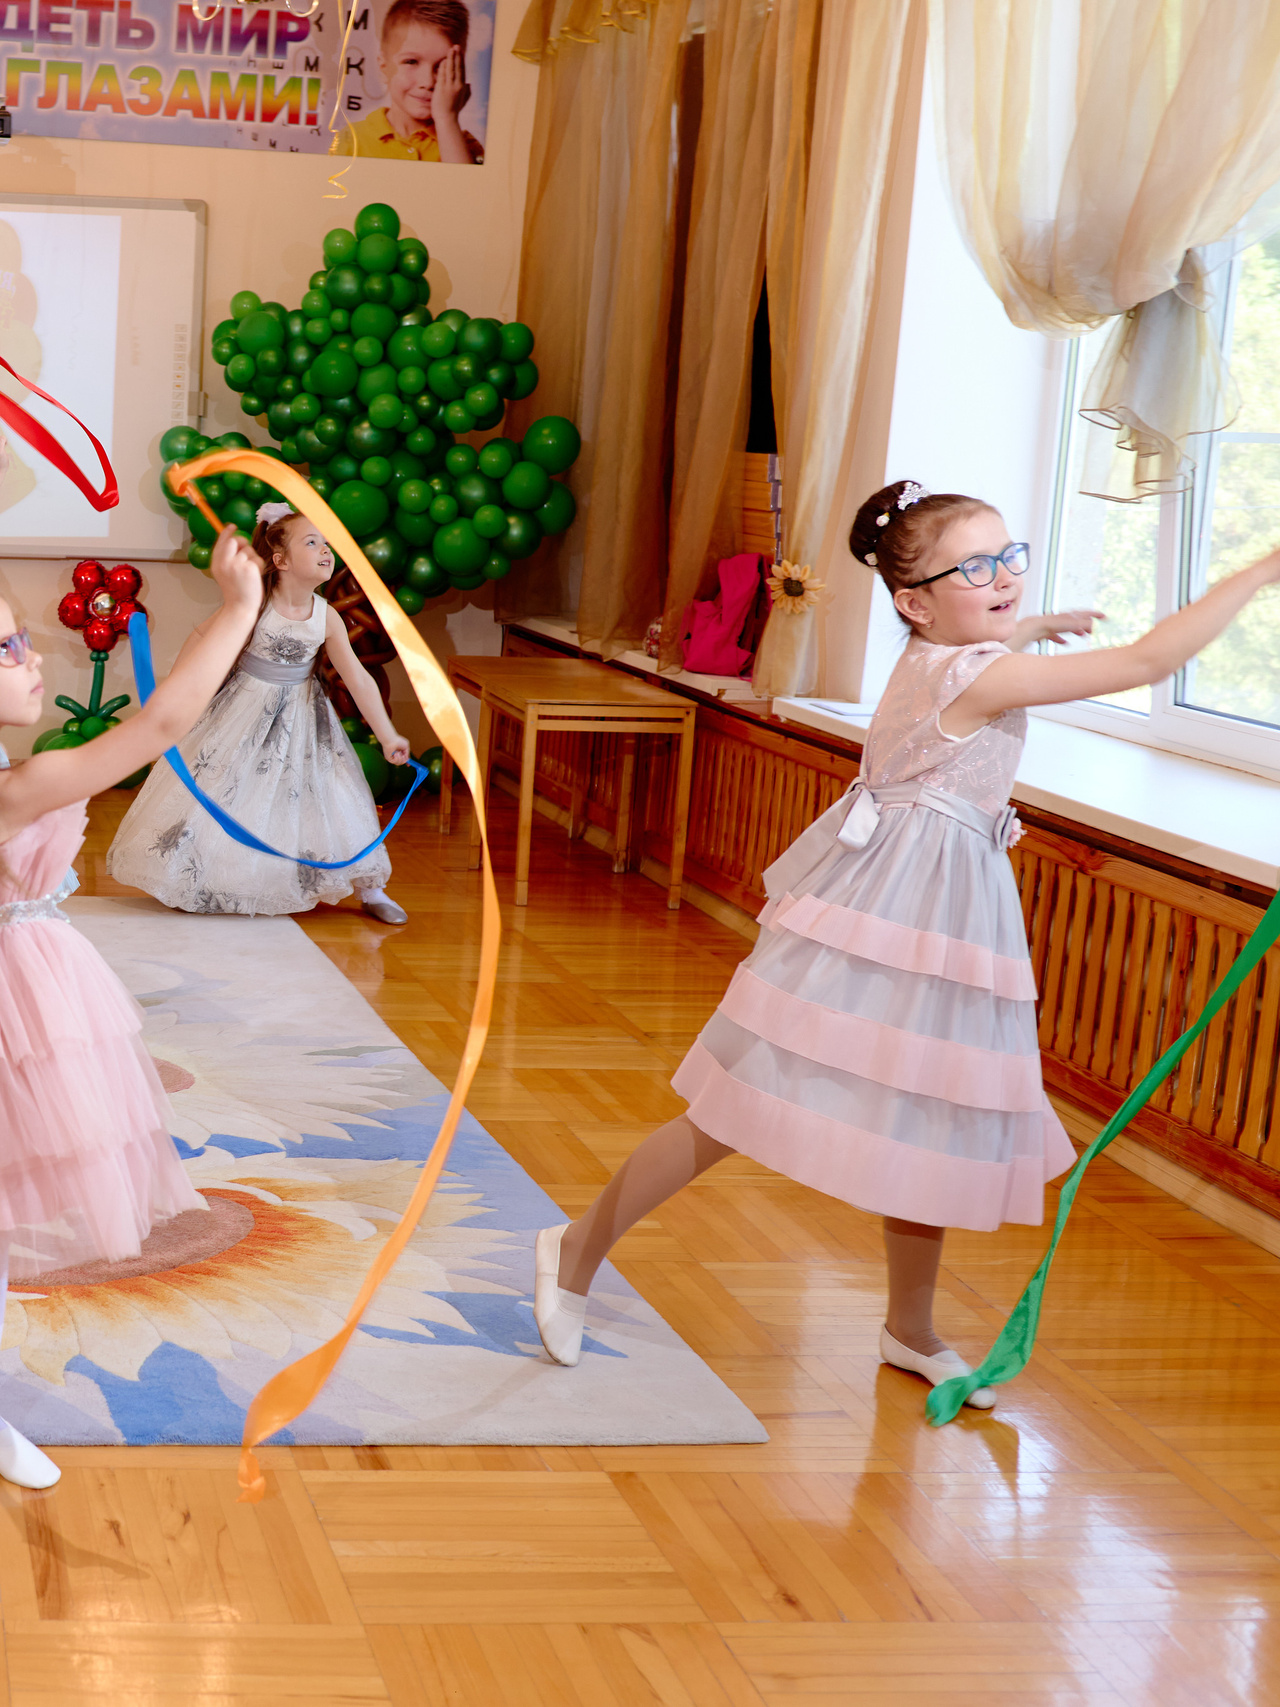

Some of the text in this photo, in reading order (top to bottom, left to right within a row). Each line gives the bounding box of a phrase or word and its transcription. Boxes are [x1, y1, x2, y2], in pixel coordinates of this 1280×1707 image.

[176, 4, 311, 60] МИР
[5, 57, 322, 126] ГЛАЗАМИ!
[347, 95, 363, 111] Б
